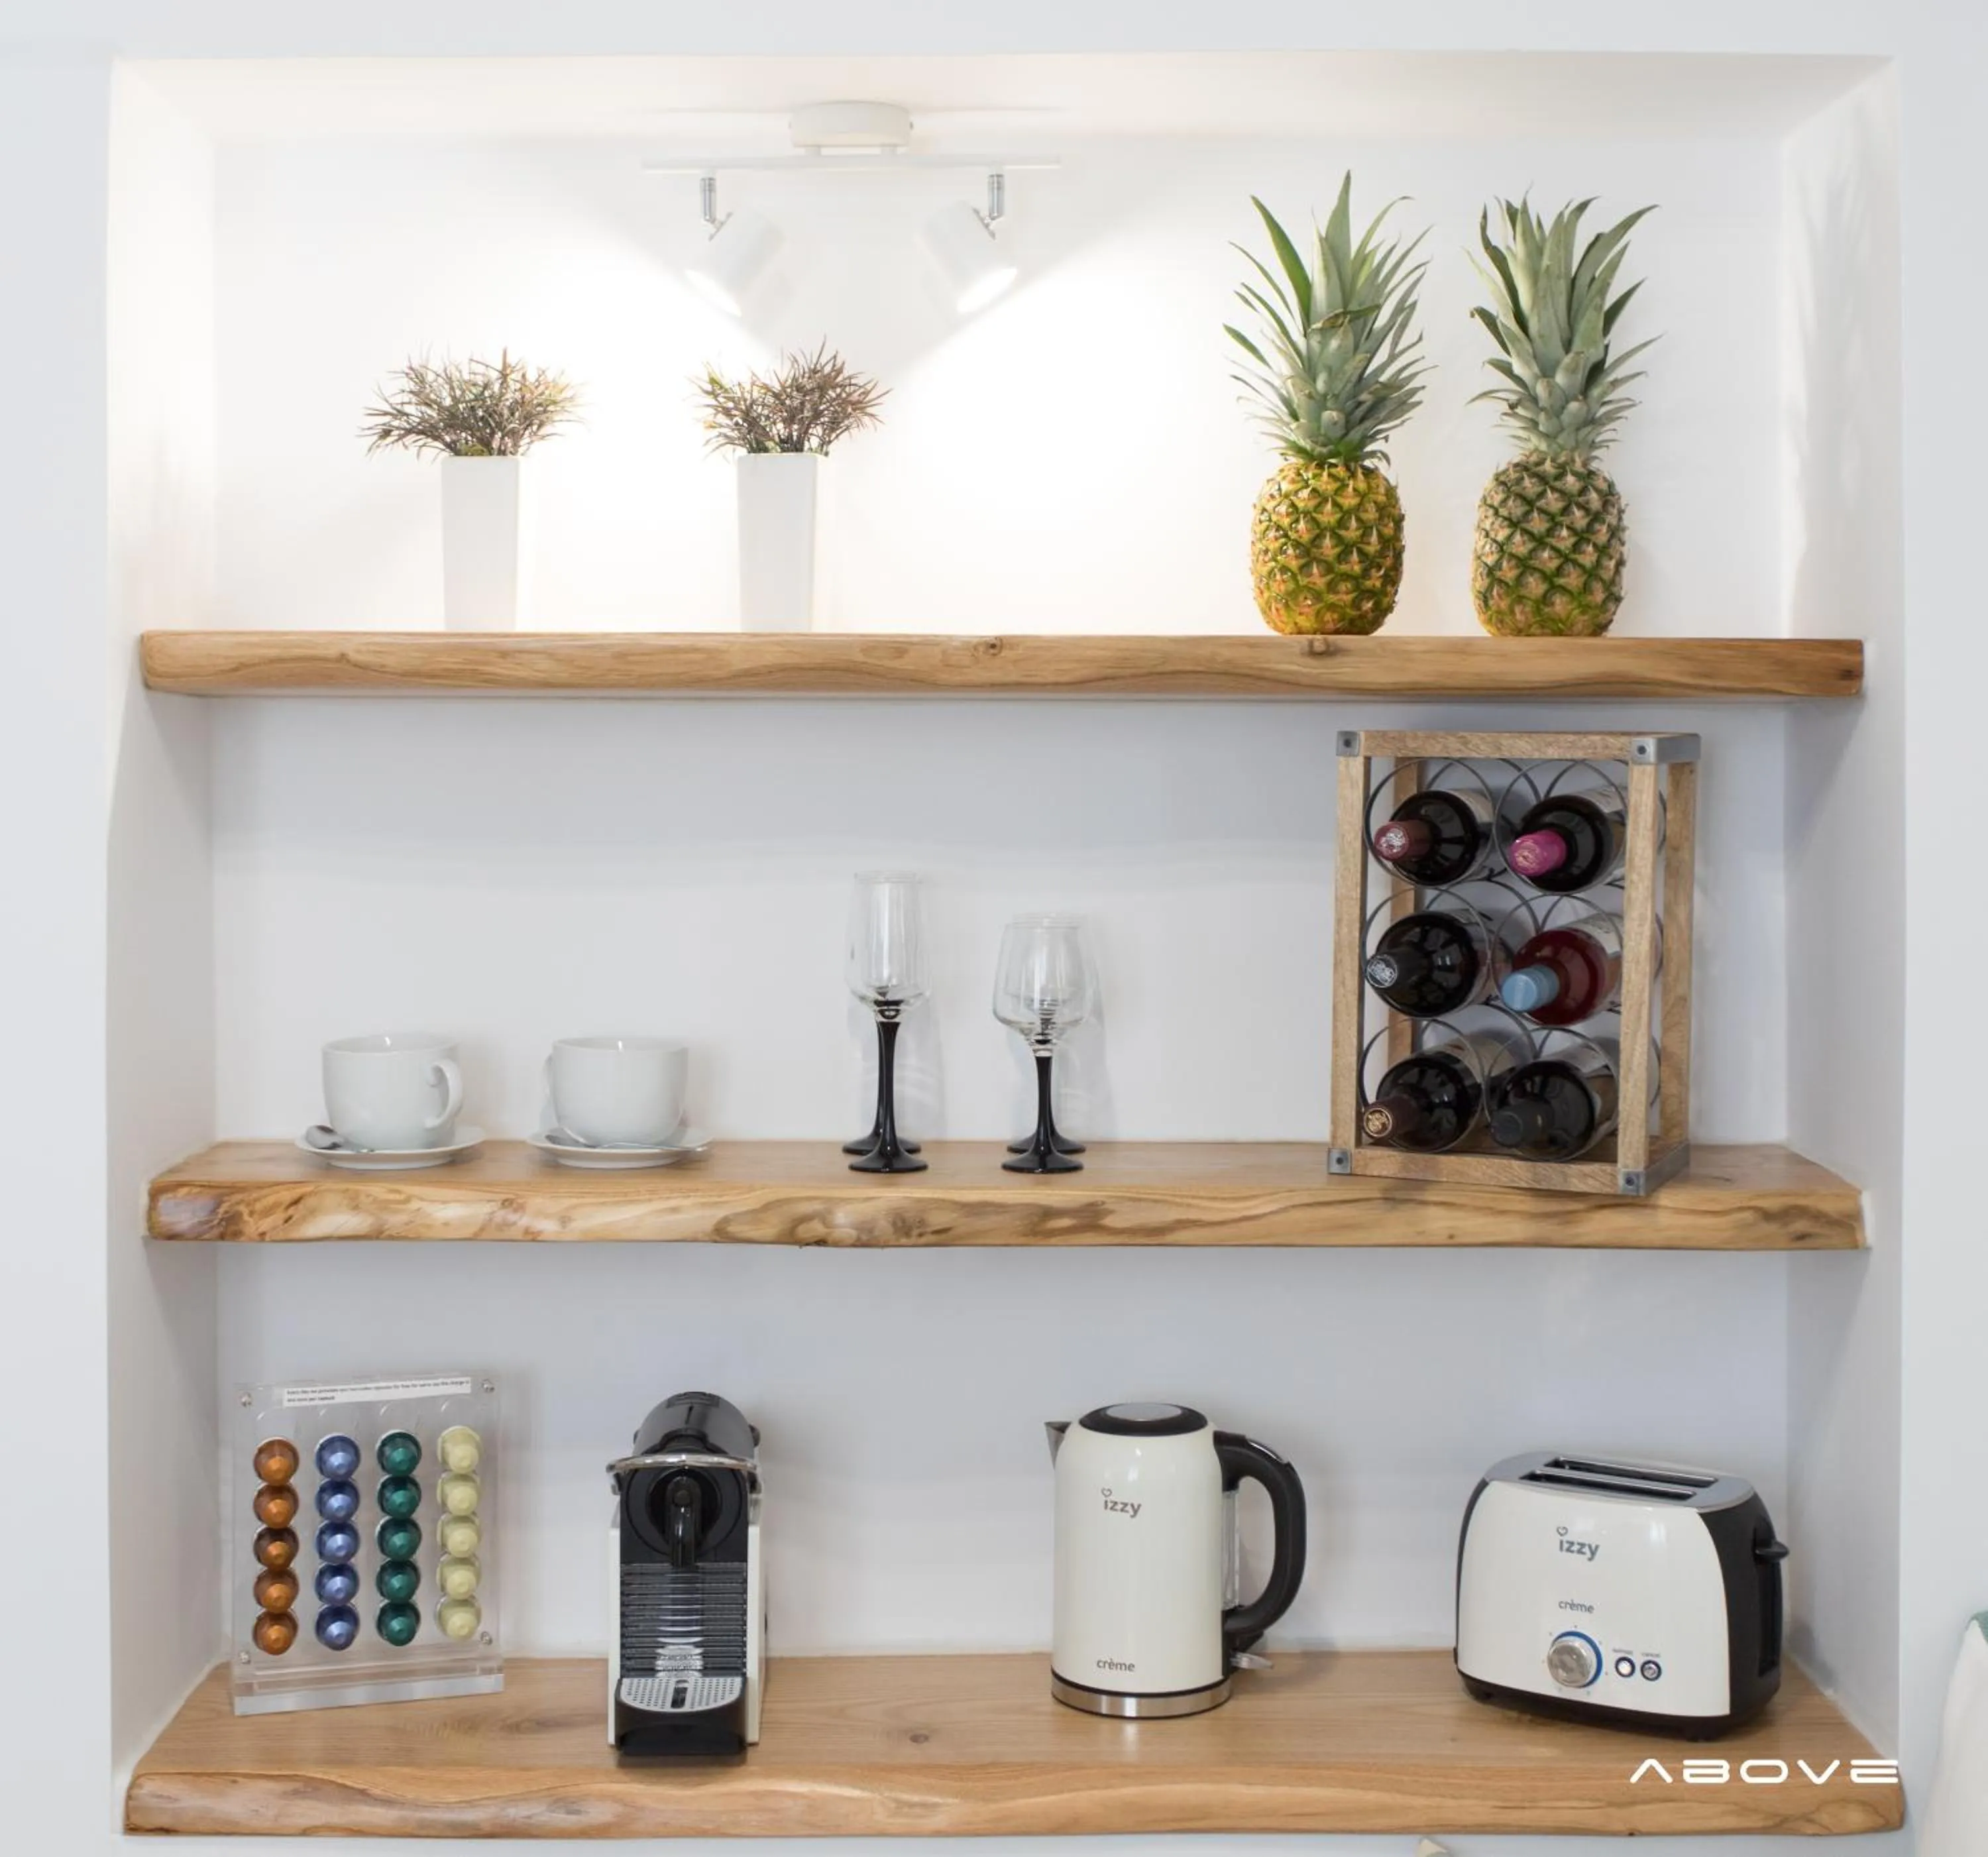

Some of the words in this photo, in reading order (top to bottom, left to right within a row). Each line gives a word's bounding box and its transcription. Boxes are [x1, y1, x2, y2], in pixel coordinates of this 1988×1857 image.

[1101, 1488, 1142, 1519] izzy
[1556, 1526, 1600, 1561] izzy
[1558, 1599, 1594, 1614] crème
[1097, 1658, 1135, 1671] crème
